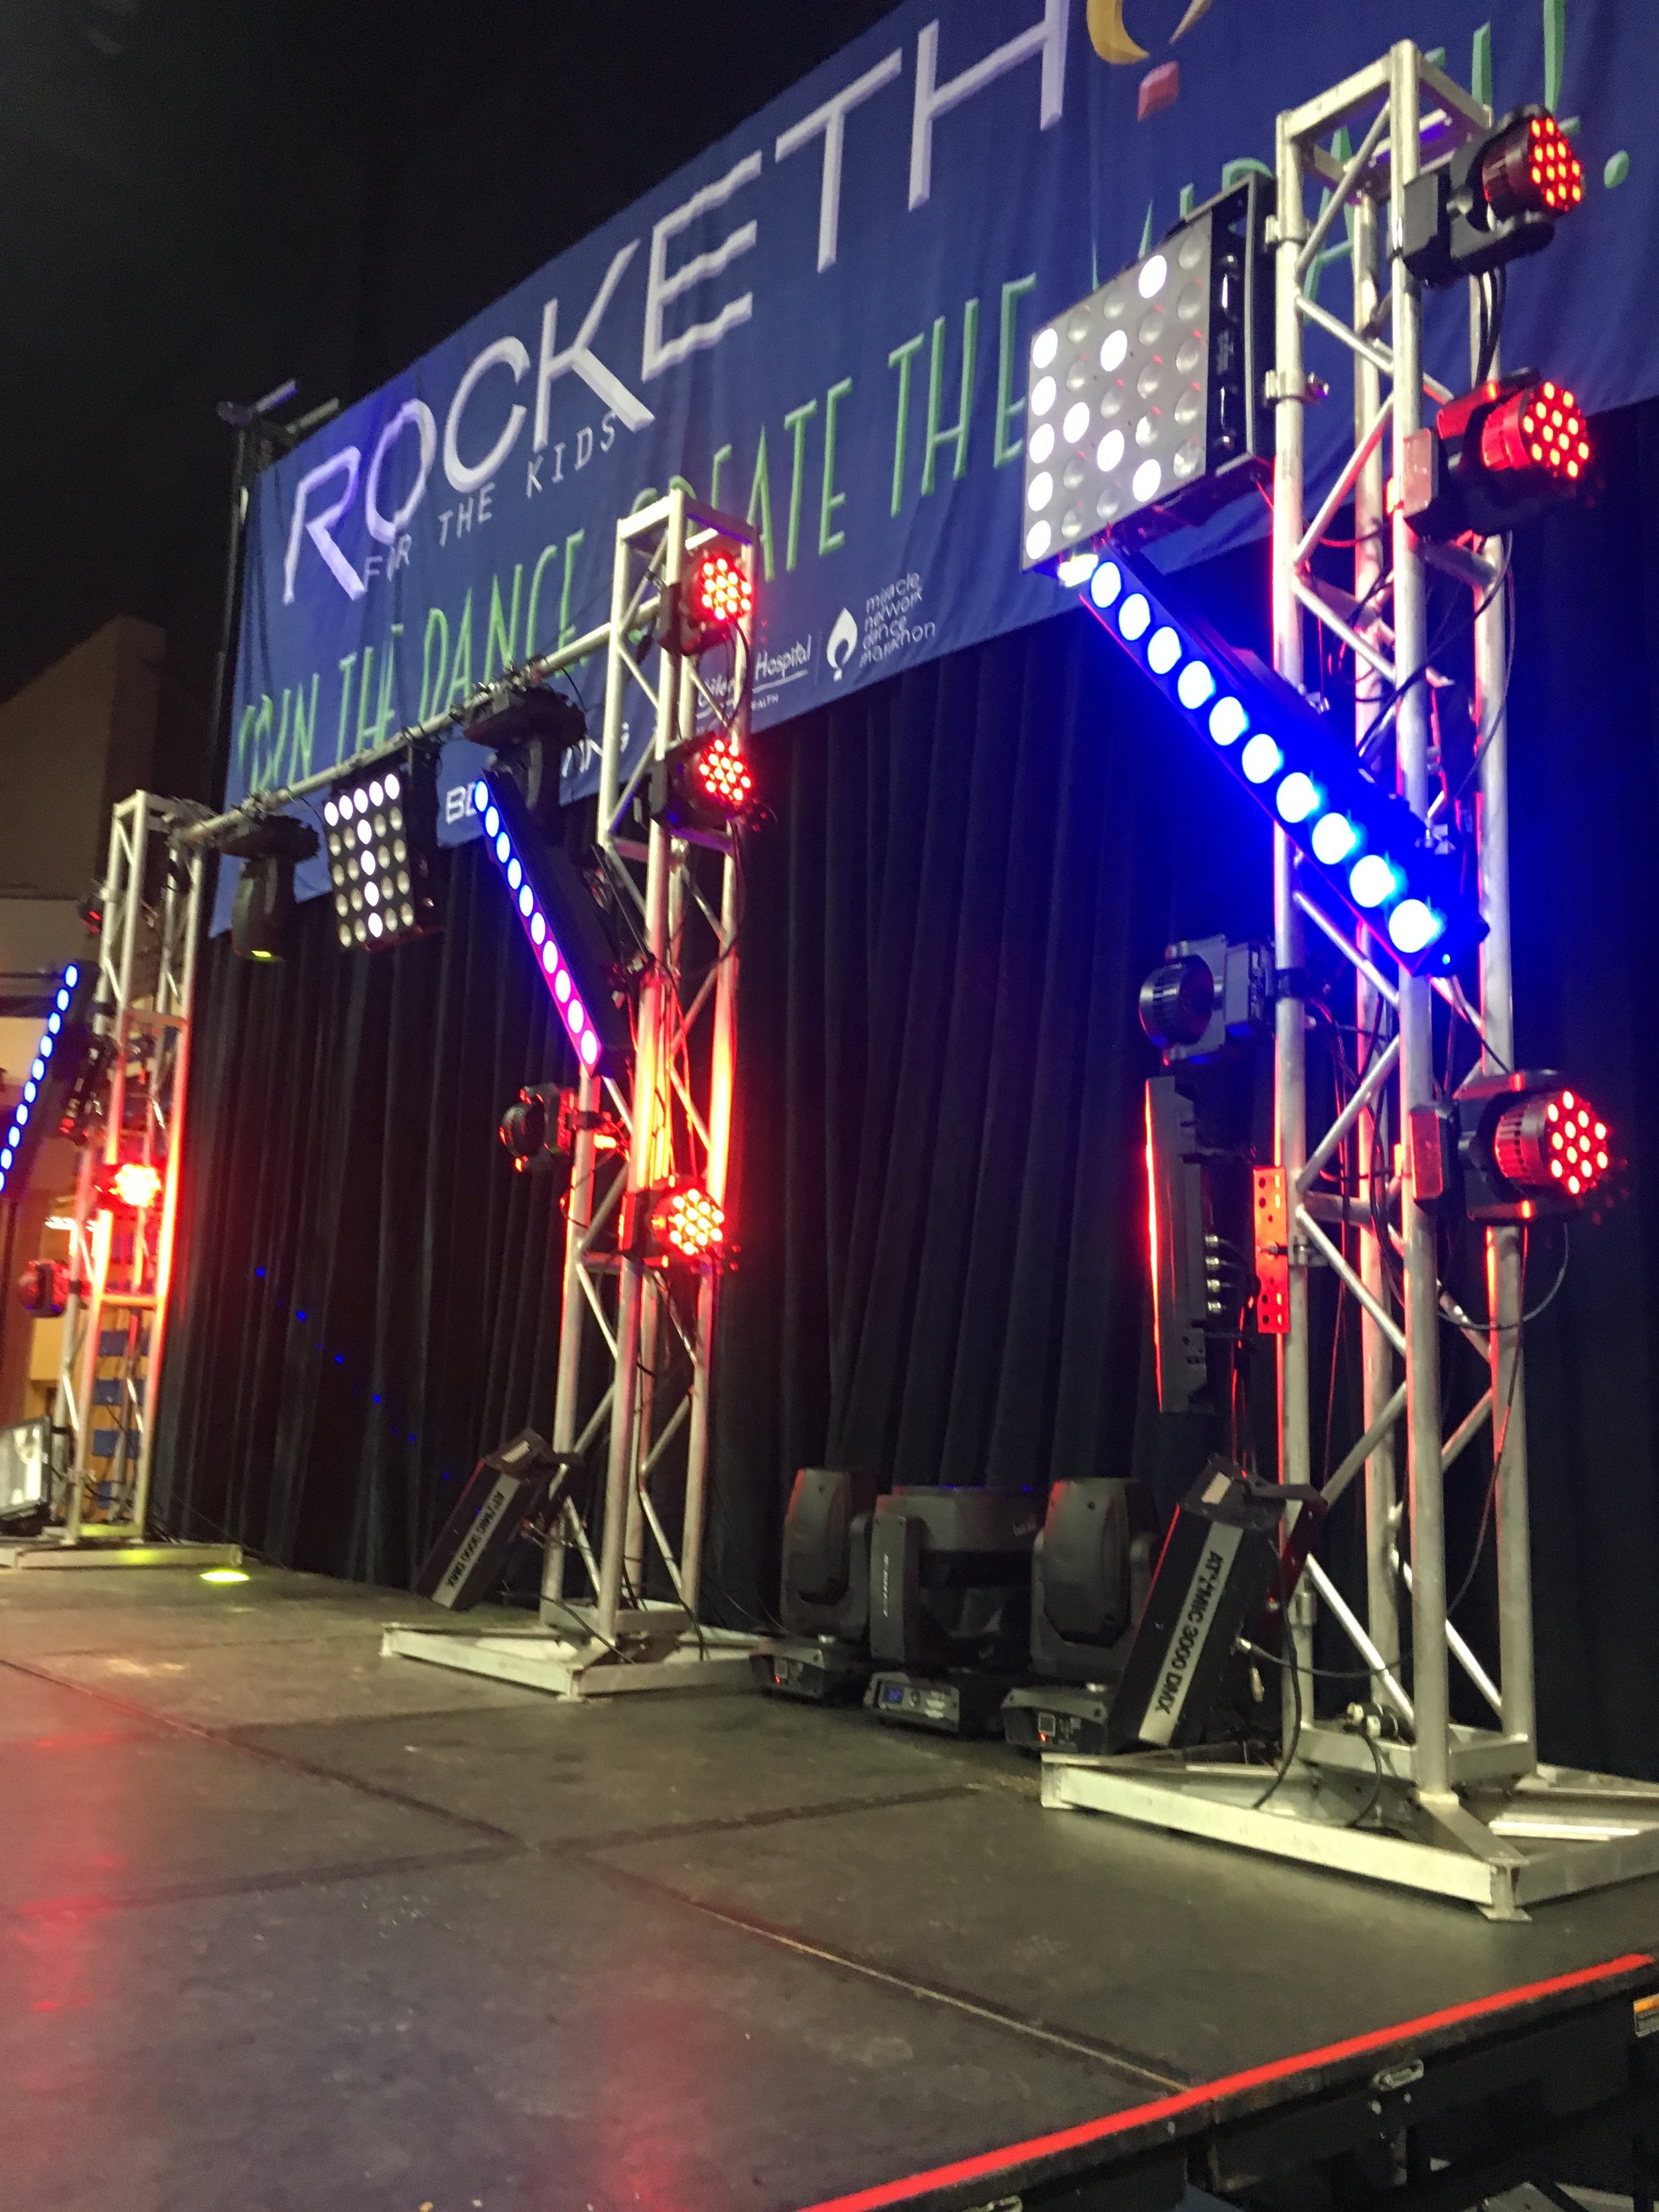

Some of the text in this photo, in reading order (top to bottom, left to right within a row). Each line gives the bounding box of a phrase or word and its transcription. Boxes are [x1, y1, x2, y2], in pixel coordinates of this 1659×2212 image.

[888, 271, 1037, 518] THE
[437, 481, 496, 548] THE
[526, 409, 617, 498] KIDS
[755, 633, 812, 682] Hospital
[1171, 1625, 1199, 1670] 3000
[1155, 1671, 1184, 1716] DMX
